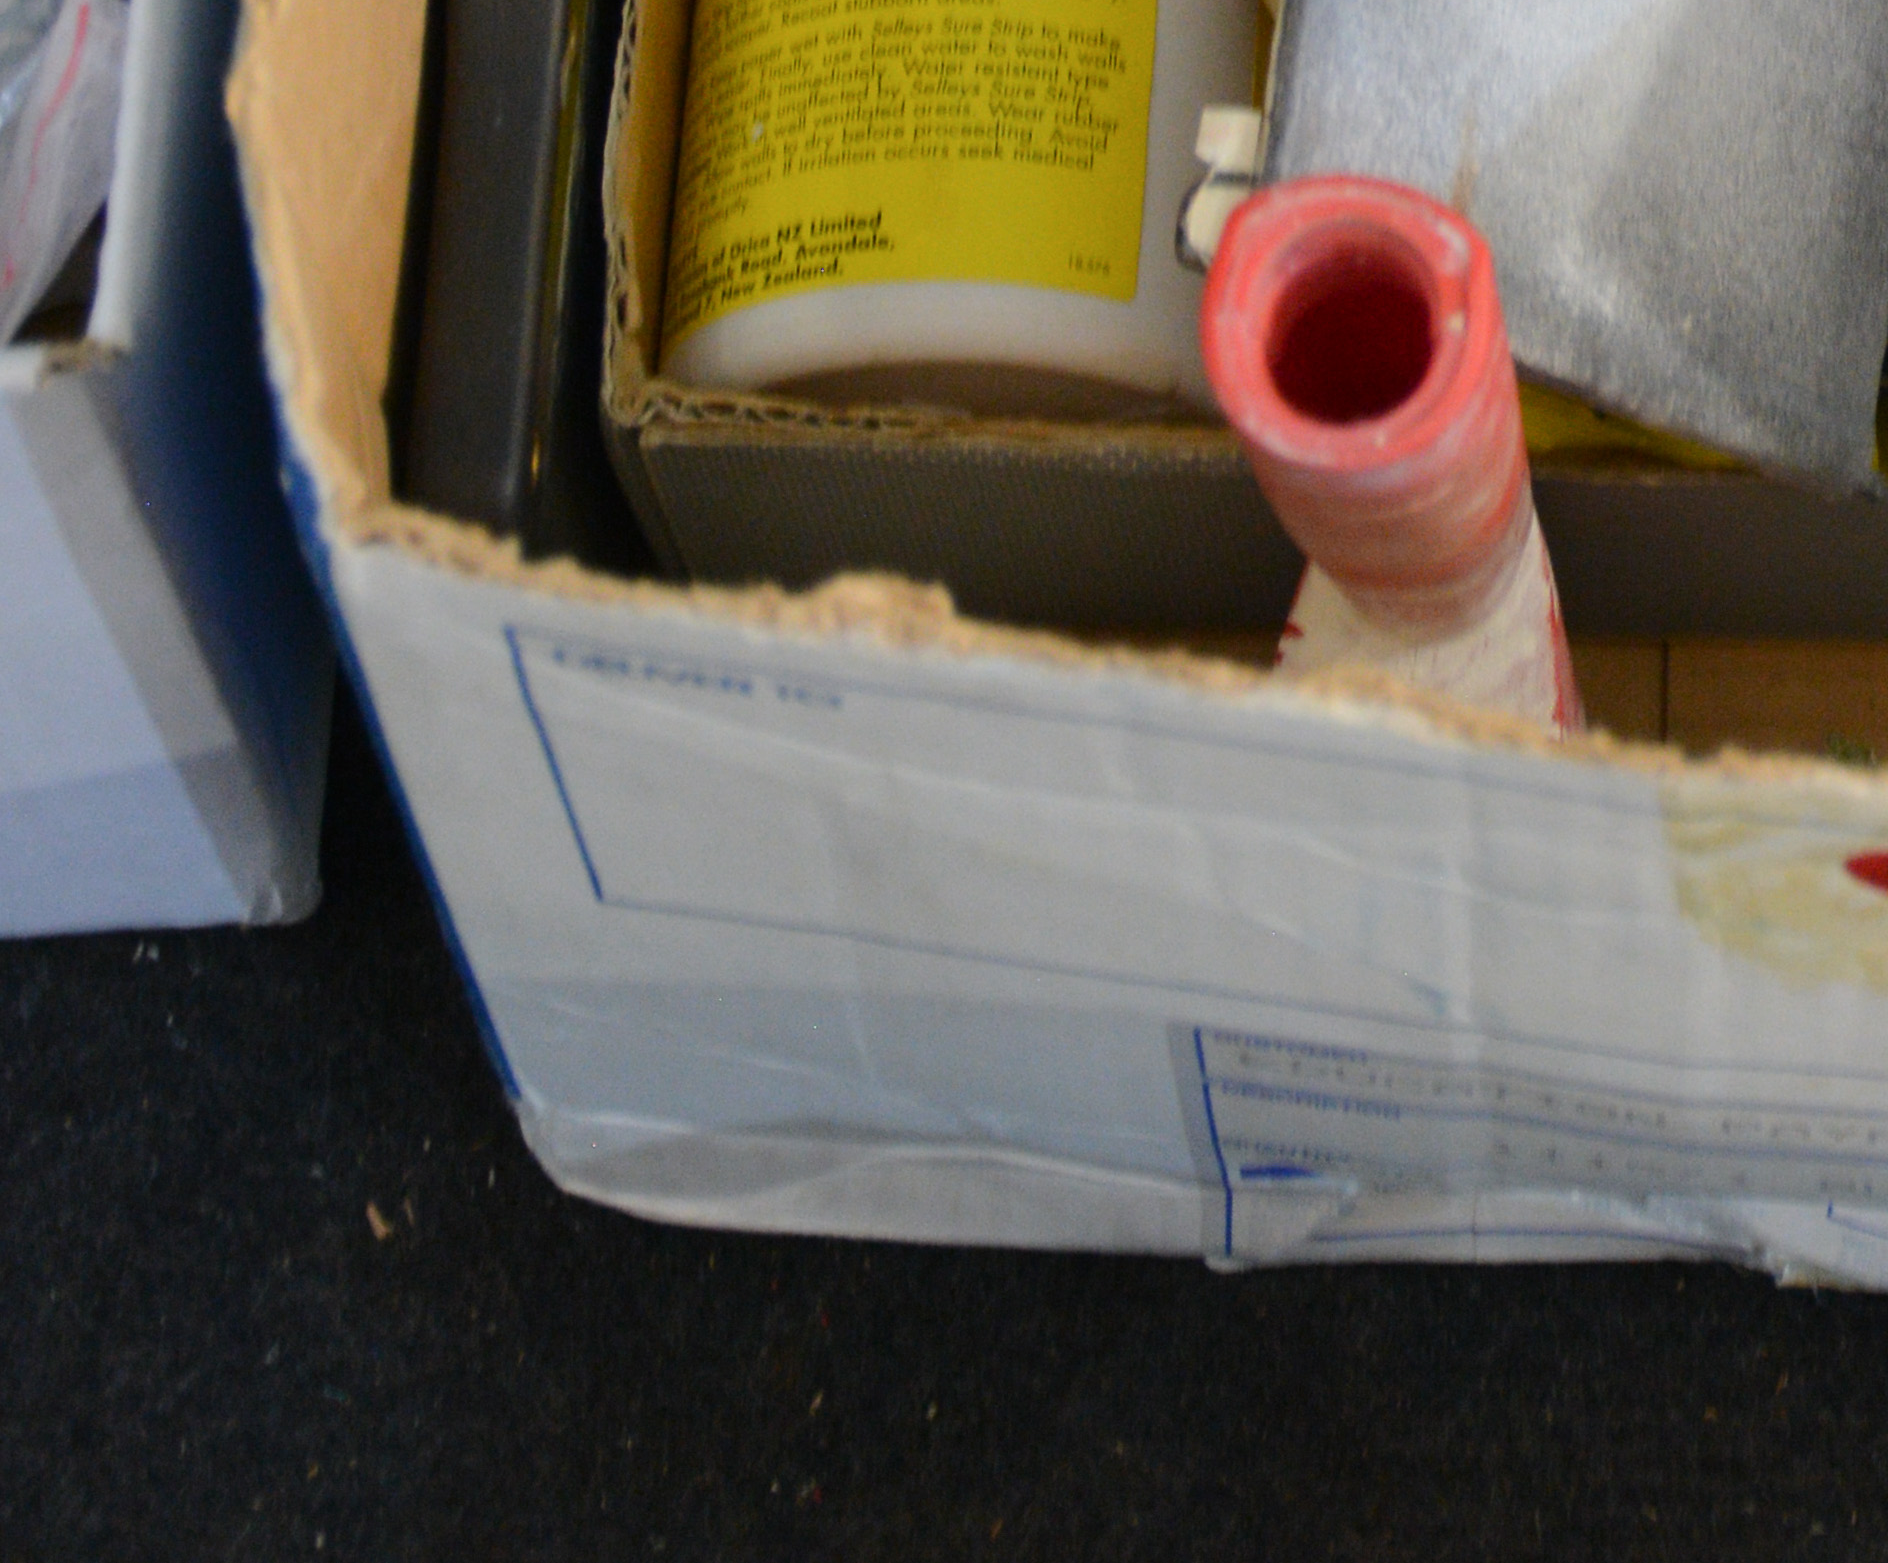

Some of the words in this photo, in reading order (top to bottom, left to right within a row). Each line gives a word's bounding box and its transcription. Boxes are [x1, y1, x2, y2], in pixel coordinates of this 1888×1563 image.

[826, 25, 862, 45] with
[943, 18, 983, 35] Sure
[991, 19, 1034, 40] Strip
[1042, 23, 1060, 40] to
[1068, 28, 1121, 52] make
[860, 40, 912, 61] clean
[921, 41, 976, 55] water
[988, 41, 1006, 57] to
[1015, 44, 1068, 62] wash
[1078, 52, 1126, 74] walls
[903, 60, 963, 77] Water
[975, 63, 1059, 83] resistant
[1068, 72, 1109, 92] type
[991, 80, 1035, 100] Sure
[989, 103, 1044, 122] Wear
[842, 125, 905, 144] before
[1048, 128, 1109, 153] Avoid
[959, 144, 1003, 161] seek
[1013, 146, 1094, 170] medical
[776, 222, 803, 245] NZ
[810, 206, 883, 237] Limited
[795, 234, 895, 262] Avondale,
[762, 257, 845, 288] Zealand.
